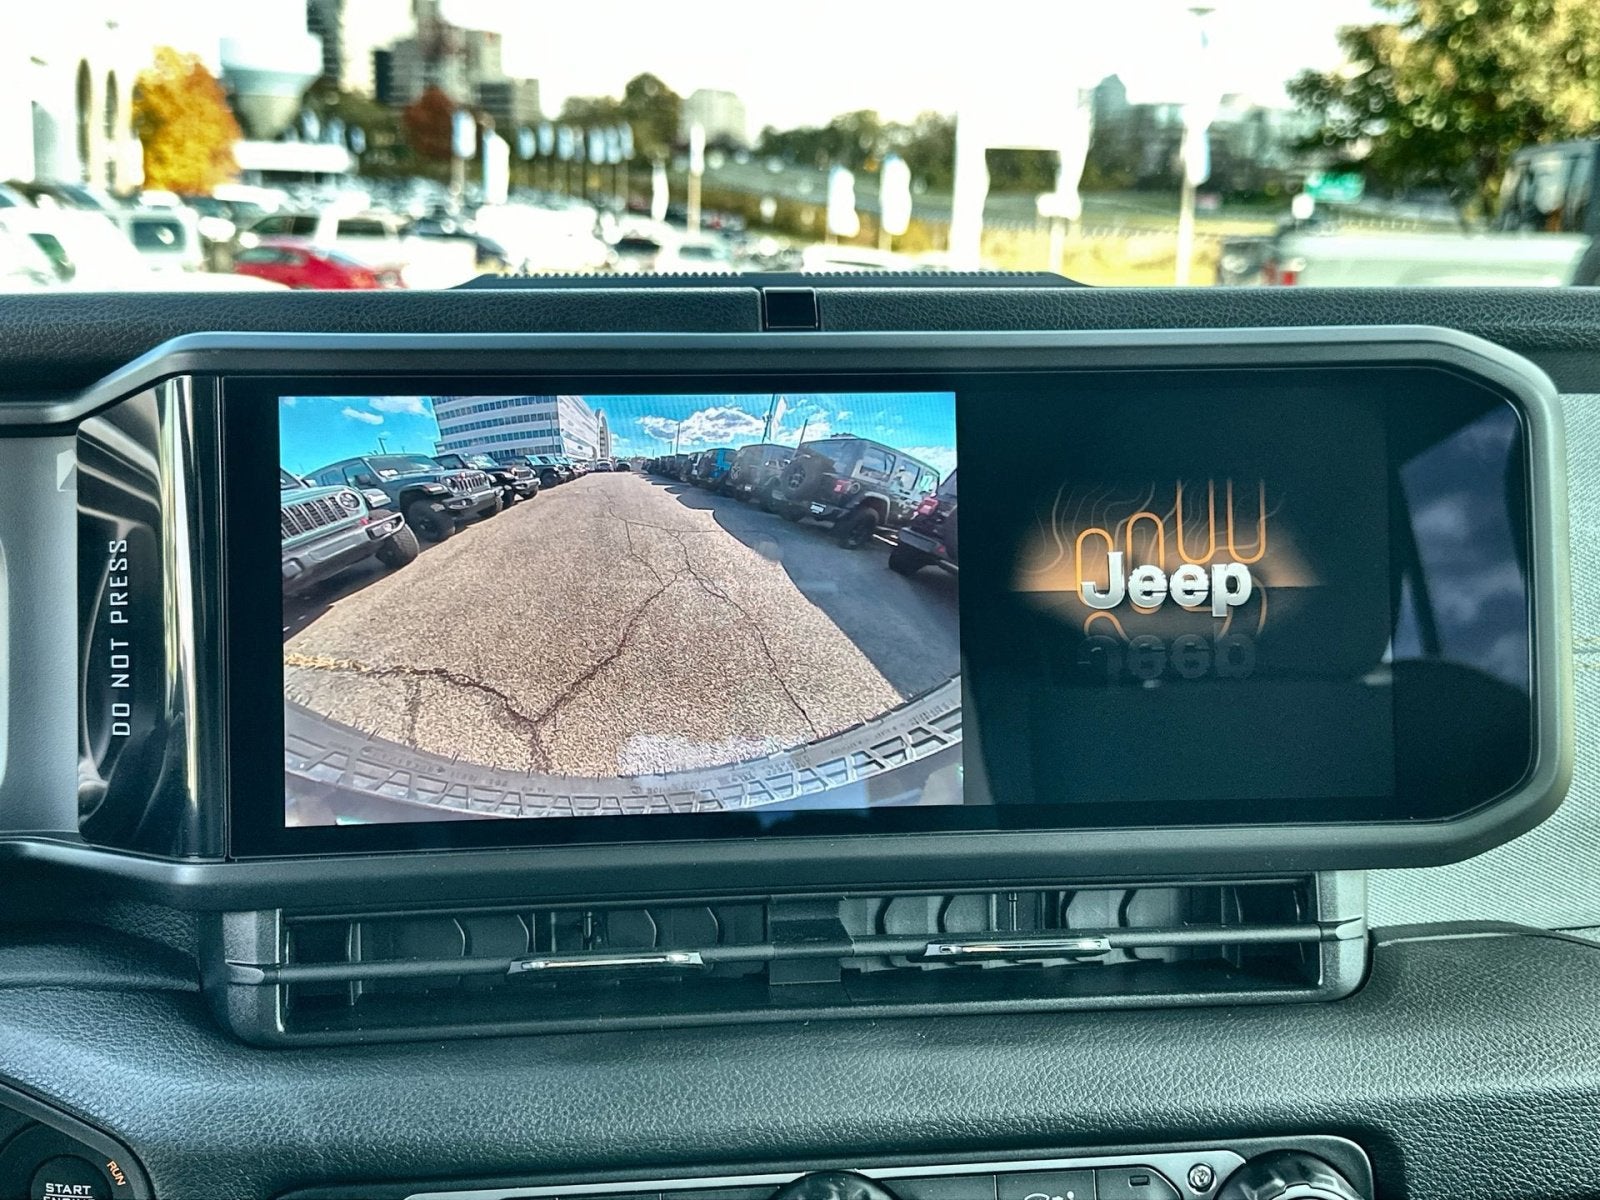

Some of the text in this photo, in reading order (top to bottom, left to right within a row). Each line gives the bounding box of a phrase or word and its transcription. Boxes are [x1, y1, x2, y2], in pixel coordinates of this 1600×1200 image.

[1080, 551, 1252, 618] Jeep
[109, 539, 131, 736] DO NOT PRESS
[45, 1182, 92, 1195] START
[106, 1160, 126, 1186] RUN
